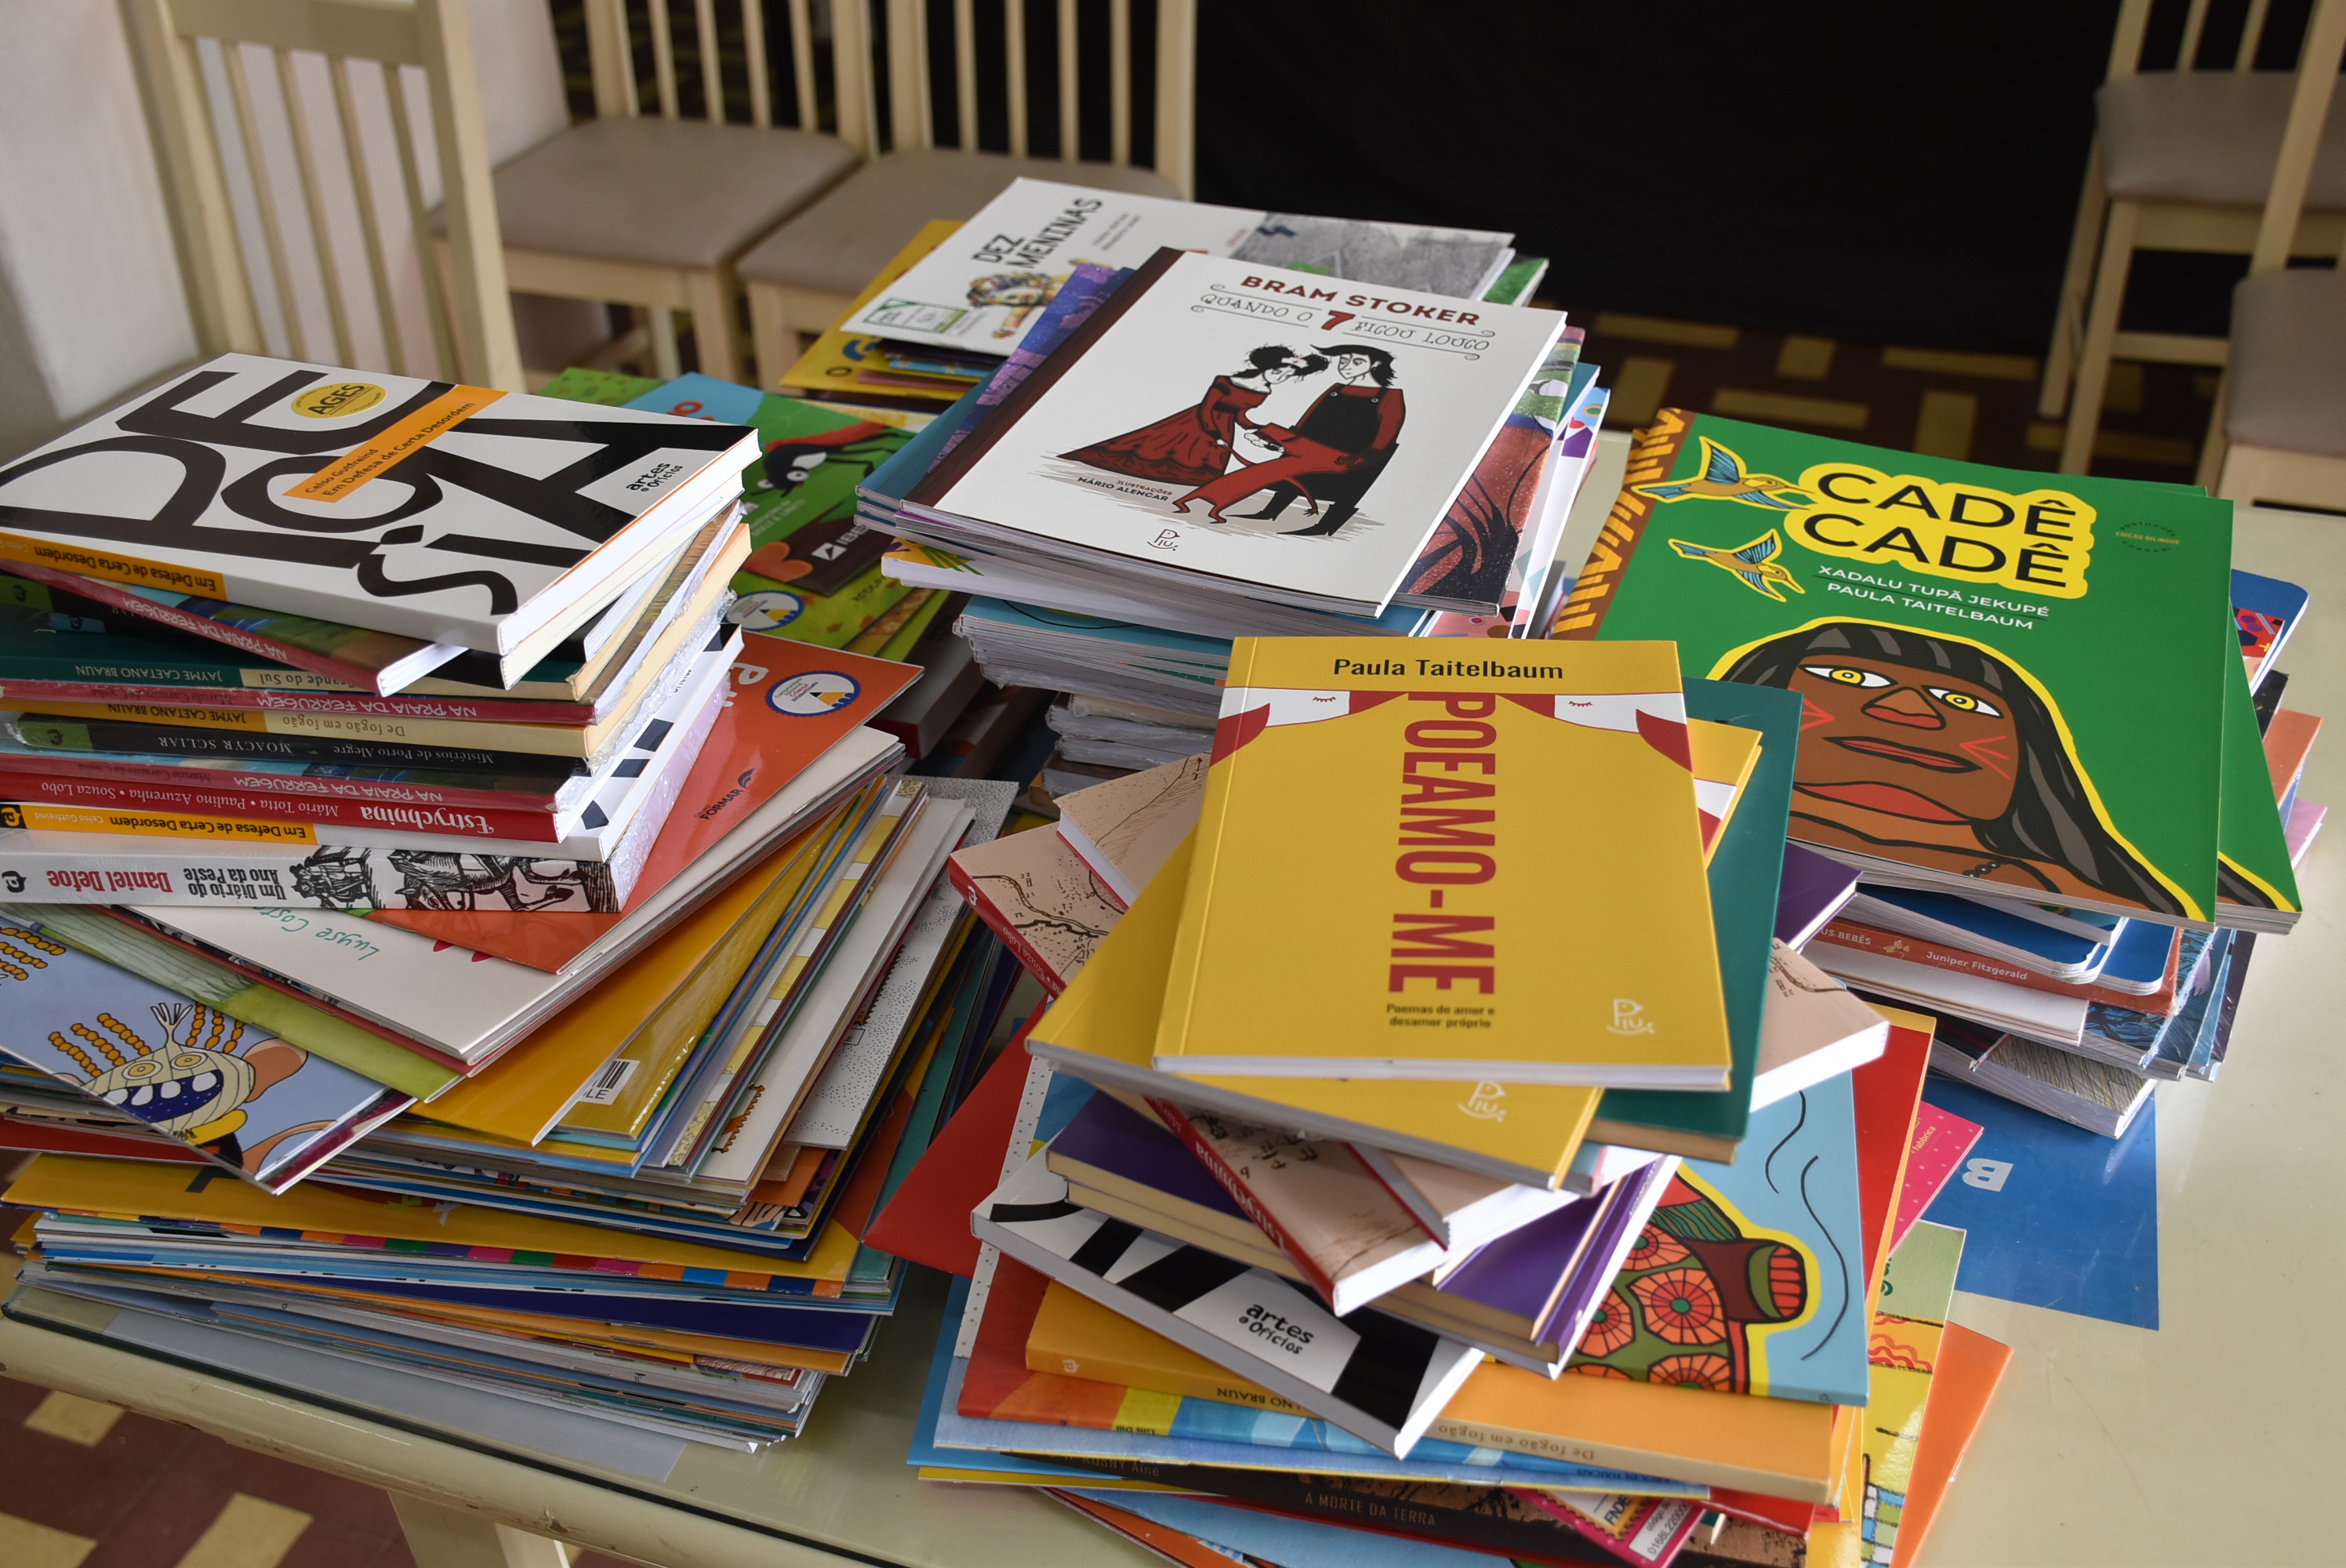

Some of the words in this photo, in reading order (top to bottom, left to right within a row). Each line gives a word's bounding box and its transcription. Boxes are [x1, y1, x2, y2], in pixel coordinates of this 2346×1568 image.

[1005, 196, 1103, 269] MENINAS
[971, 233, 1024, 263] DEZ
[1240, 275, 1338, 302] BRAM
[1344, 294, 1481, 326] STOKER
[1200, 292, 1290, 318] QUANDO
[1296, 310, 1313, 322] O
[1320, 310, 1356, 331] 7
[1351, 320, 1415, 340] FICOU
[1422, 332, 1491, 352] LOUCO
[307, 384, 365, 415] AGES
[322, 485, 347, 496] Em
[345, 460, 383, 485] Defesa
[382, 449, 397, 461] de
[394, 432, 425, 452] Certa
[421, 402, 475, 435] Desordem
[305, 474, 335, 494] Celso
[332, 448, 379, 477] Gutfreind
[625, 463, 670, 492] artes
[1077, 475, 1115, 490] MÁRIO
[1114, 485, 1169, 502] ALENCAR
[1117, 479, 1173, 496] ILUSTRAÇÕES
[1818, 472, 2077, 542] CADÊ
[2115, 532, 2144, 540] EDIÇÃO
[34, 545, 96, 569] Desordem
[1803, 513, 2069, 588] CADÊ
[98, 559, 132, 575] Certa
[133, 565, 148, 579] de
[151, 568, 192, 587] Defesa
[196, 578, 216, 592] Em
[1818, 565, 1904, 590] XADALU
[1908, 583, 1963, 602] TUPÃ
[1967, 594, 2050, 618] JEKUPÉ
[1826, 583, 1896, 604] PAULA
[1901, 597, 2033, 630] TAITELBAUM
[122, 597, 201, 635] FERRUGEM
[197, 622, 220, 638] DA
[221, 629, 264, 654] PRAIA
[267, 644, 287, 660] NA
[76, 665, 118, 677] BRAUN
[121, 667, 181, 681] CAETANO
[184, 670, 223, 682] JAYME
[1334, 659, 1406, 677] Paula
[1415, 659, 1563, 679] Taitelbaum
[260, 673, 282, 685] Sul
[286, 673, 303, 686] do
[307, 674, 354, 689] rande
[107, 703, 149, 716] BRAUN
[256, 696, 358, 711] FERRUGEM
[359, 700, 390, 713] DA
[390, 702, 447, 716] PRAIA
[453, 704, 478, 717] NA
[151, 707, 207, 720] CAETANO
[208, 712, 248, 724] JAYME
[282, 714, 319, 730] fogão
[323, 720, 342, 729] em
[346, 720, 383, 735] fogão
[387, 724, 405, 738] De
[158, 735, 216, 750] SCLIAR
[223, 739, 292, 754] MOACYR
[333, 745, 374, 758] Alegre
[377, 749, 412, 760] Porto
[416, 750, 432, 760] de
[435, 751, 494, 764] Mistérios
[41, 782, 74, 796] Lobo
[234, 776, 329, 793] FERRUGEM
[332, 784, 359, 796] DA
[77, 786, 116, 800] Souza
[129, 789, 192, 805] Azurenha
[361, 786, 415, 800] PRAIA
[416, 790, 443, 802] NA
[196, 795, 246, 809] Paulino
[260, 798, 295, 813] Totta
[699, 789, 743, 819] FORMAR
[34, 811, 78, 823] Gutfreind
[299, 803, 339, 817] Mário
[79, 814, 104, 824] Celso
[110, 815, 177, 831] Desordem
[179, 820, 216, 833] Certa
[360, 805, 495, 834] Estrychnina
[216, 822, 234, 834] de
[236, 823, 281, 837] Defesa
[284, 826, 307, 838] Em
[1389, 692, 1497, 994] POEAMO-ME
[46, 869, 105, 891] Defoe
[107, 869, 173, 894] Daniel
[183, 867, 225, 884] Peste
[227, 868, 249, 883] da
[252, 869, 279, 884] Ano
[188, 883, 209, 897] do
[211, 884, 258, 901] Diário
[262, 884, 288, 900] Um
[252, 906, 310, 932] Cost
[1003, 927, 1021, 953] Lobo
[1838, 931, 1872, 946] BEBÊS
[1926, 951, 1968, 969] Juniper
[1972, 960, 2028, 981] Fitzgerald
[1022, 948, 1045, 980] Souza
[1386, 1004, 1434, 1014] Poemas
[1436, 1004, 1451, 1015] de
[1453, 1007, 1485, 1016] amor
[1487, 1007, 1495, 1016] e
[1389, 1017, 1442, 1027] desamor
[1445, 1017, 1491, 1029] próprio
[583, 1088, 609, 1099] LE
[1912, 1126, 1936, 1151] fabbrica
[1245, 1303, 1314, 1344] artes
[1217, 1386, 1266, 1406] BRAUN
[1439, 1423, 1486, 1443] fogão
[1491, 1432, 1514, 1445] em
[1518, 1437, 1566, 1458] fogão
[1572, 1447, 1594, 1461] De
[1306, 1492, 1313, 1504] A
[1318, 1494, 1364, 1514] MORTE
[1369, 1500, 1388, 1516] DA
[1393, 1504, 1436, 1526] TERRA
[1603, 1494, 1628, 1526] FNDE
